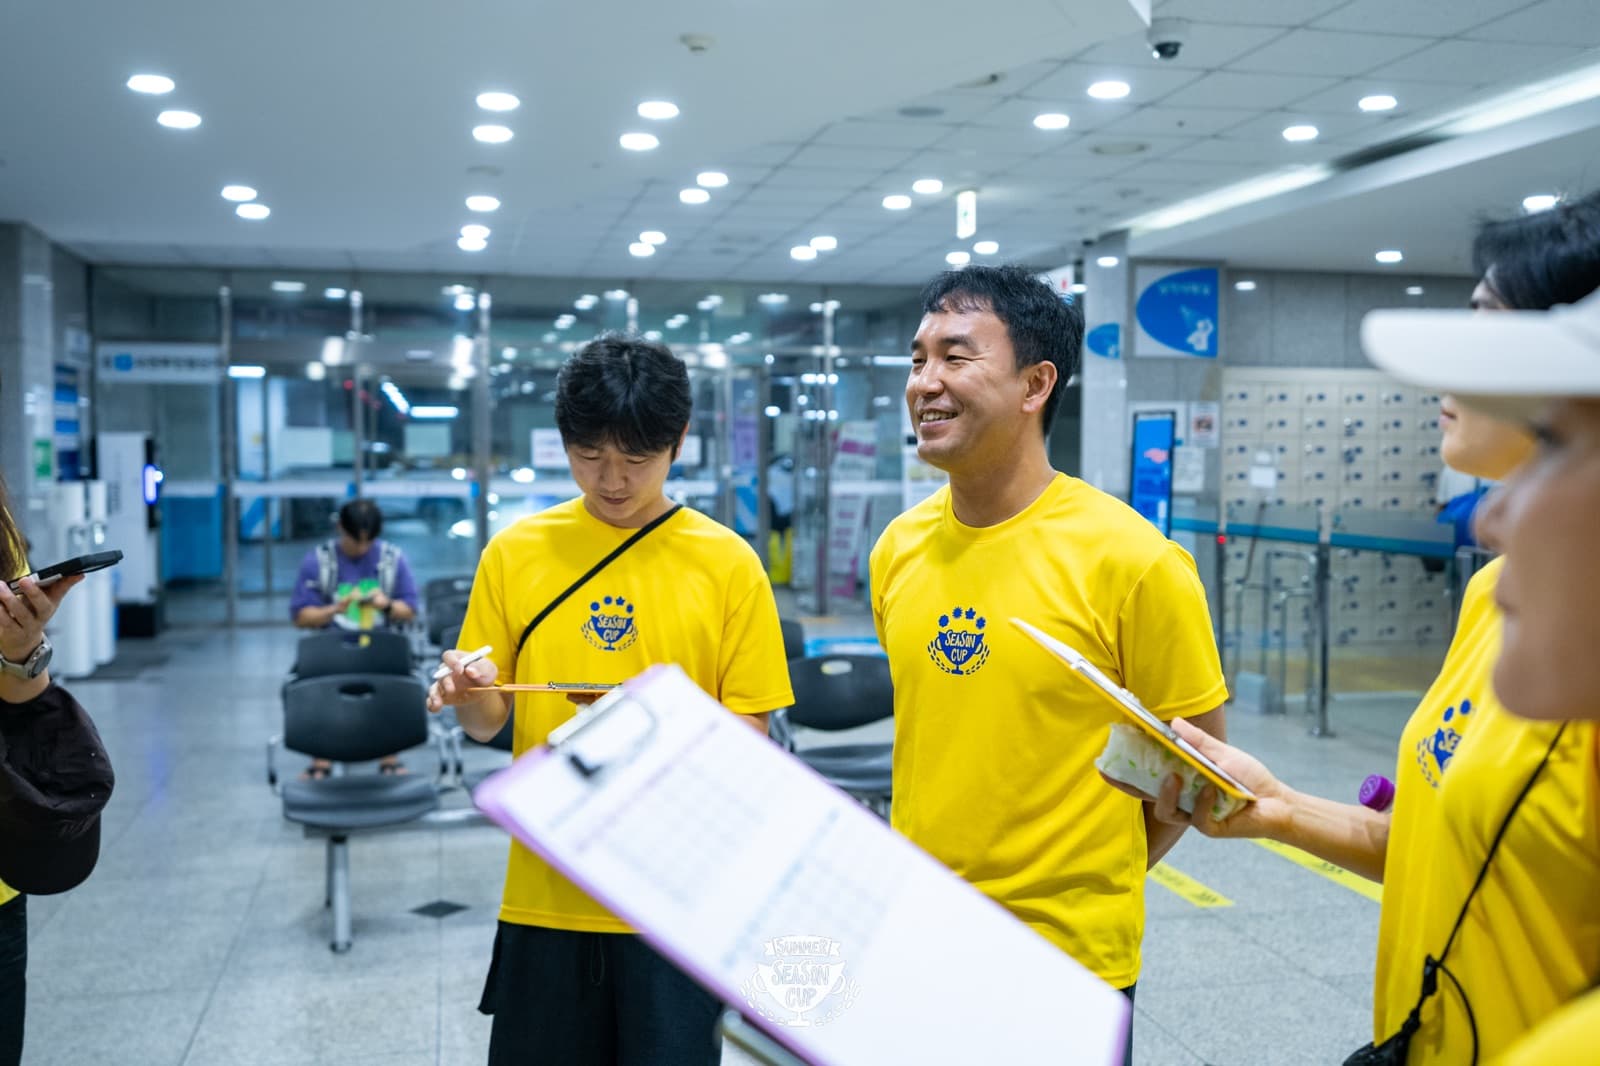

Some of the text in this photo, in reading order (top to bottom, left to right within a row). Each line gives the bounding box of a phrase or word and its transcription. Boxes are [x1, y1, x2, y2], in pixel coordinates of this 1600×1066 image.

[597, 615, 626, 629] SEASON
[603, 629, 619, 640] CUP
[945, 630, 976, 648] SEASON
[951, 648, 968, 662] CUP
